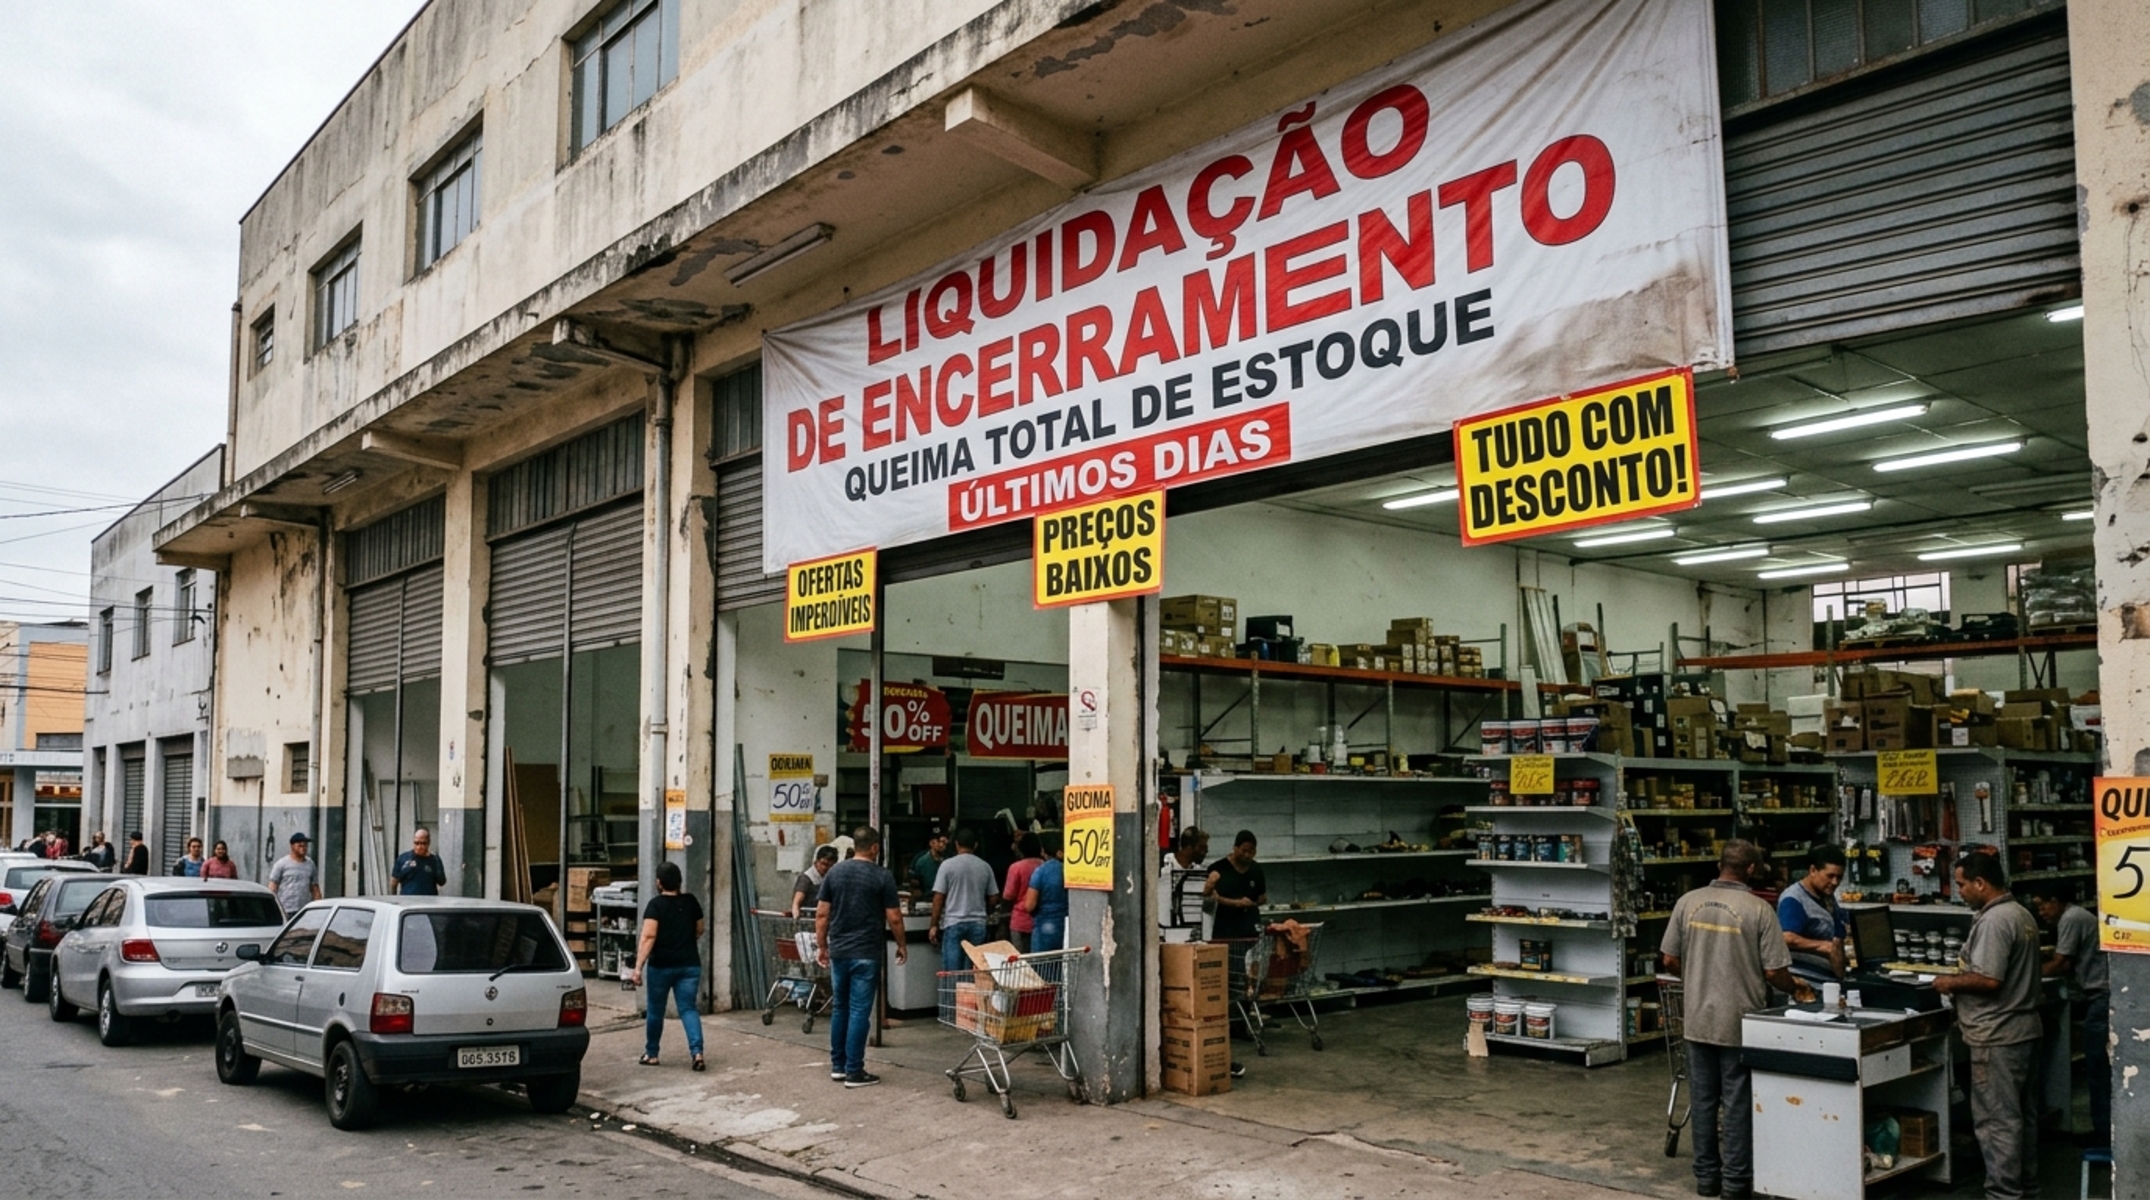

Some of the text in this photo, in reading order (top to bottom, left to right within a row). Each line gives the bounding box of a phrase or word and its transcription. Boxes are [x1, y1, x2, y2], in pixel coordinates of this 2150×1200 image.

[867, 84, 1430, 365] LIQUIDAÇÃO
[788, 134, 1616, 472] DE ENCERRAMENTO
[845, 289, 1495, 501] QUEIMA TOTAL DE ESTOQUE
[1471, 386, 1674, 473] TUDO COM
[960, 419, 1271, 522] ÚLTIMOS DIAS
[1471, 444, 1688, 529] DESCONTO!
[1043, 500, 1155, 553] PREÇOS
[798, 559, 863, 597] OFERTAS
[1046, 547, 1152, 597] BAIXOS
[908, 724, 943, 742] OFF
[975, 703, 1069, 749] QUEIMA
[773, 783, 801, 809] 50
[1067, 829, 1099, 865] 50
